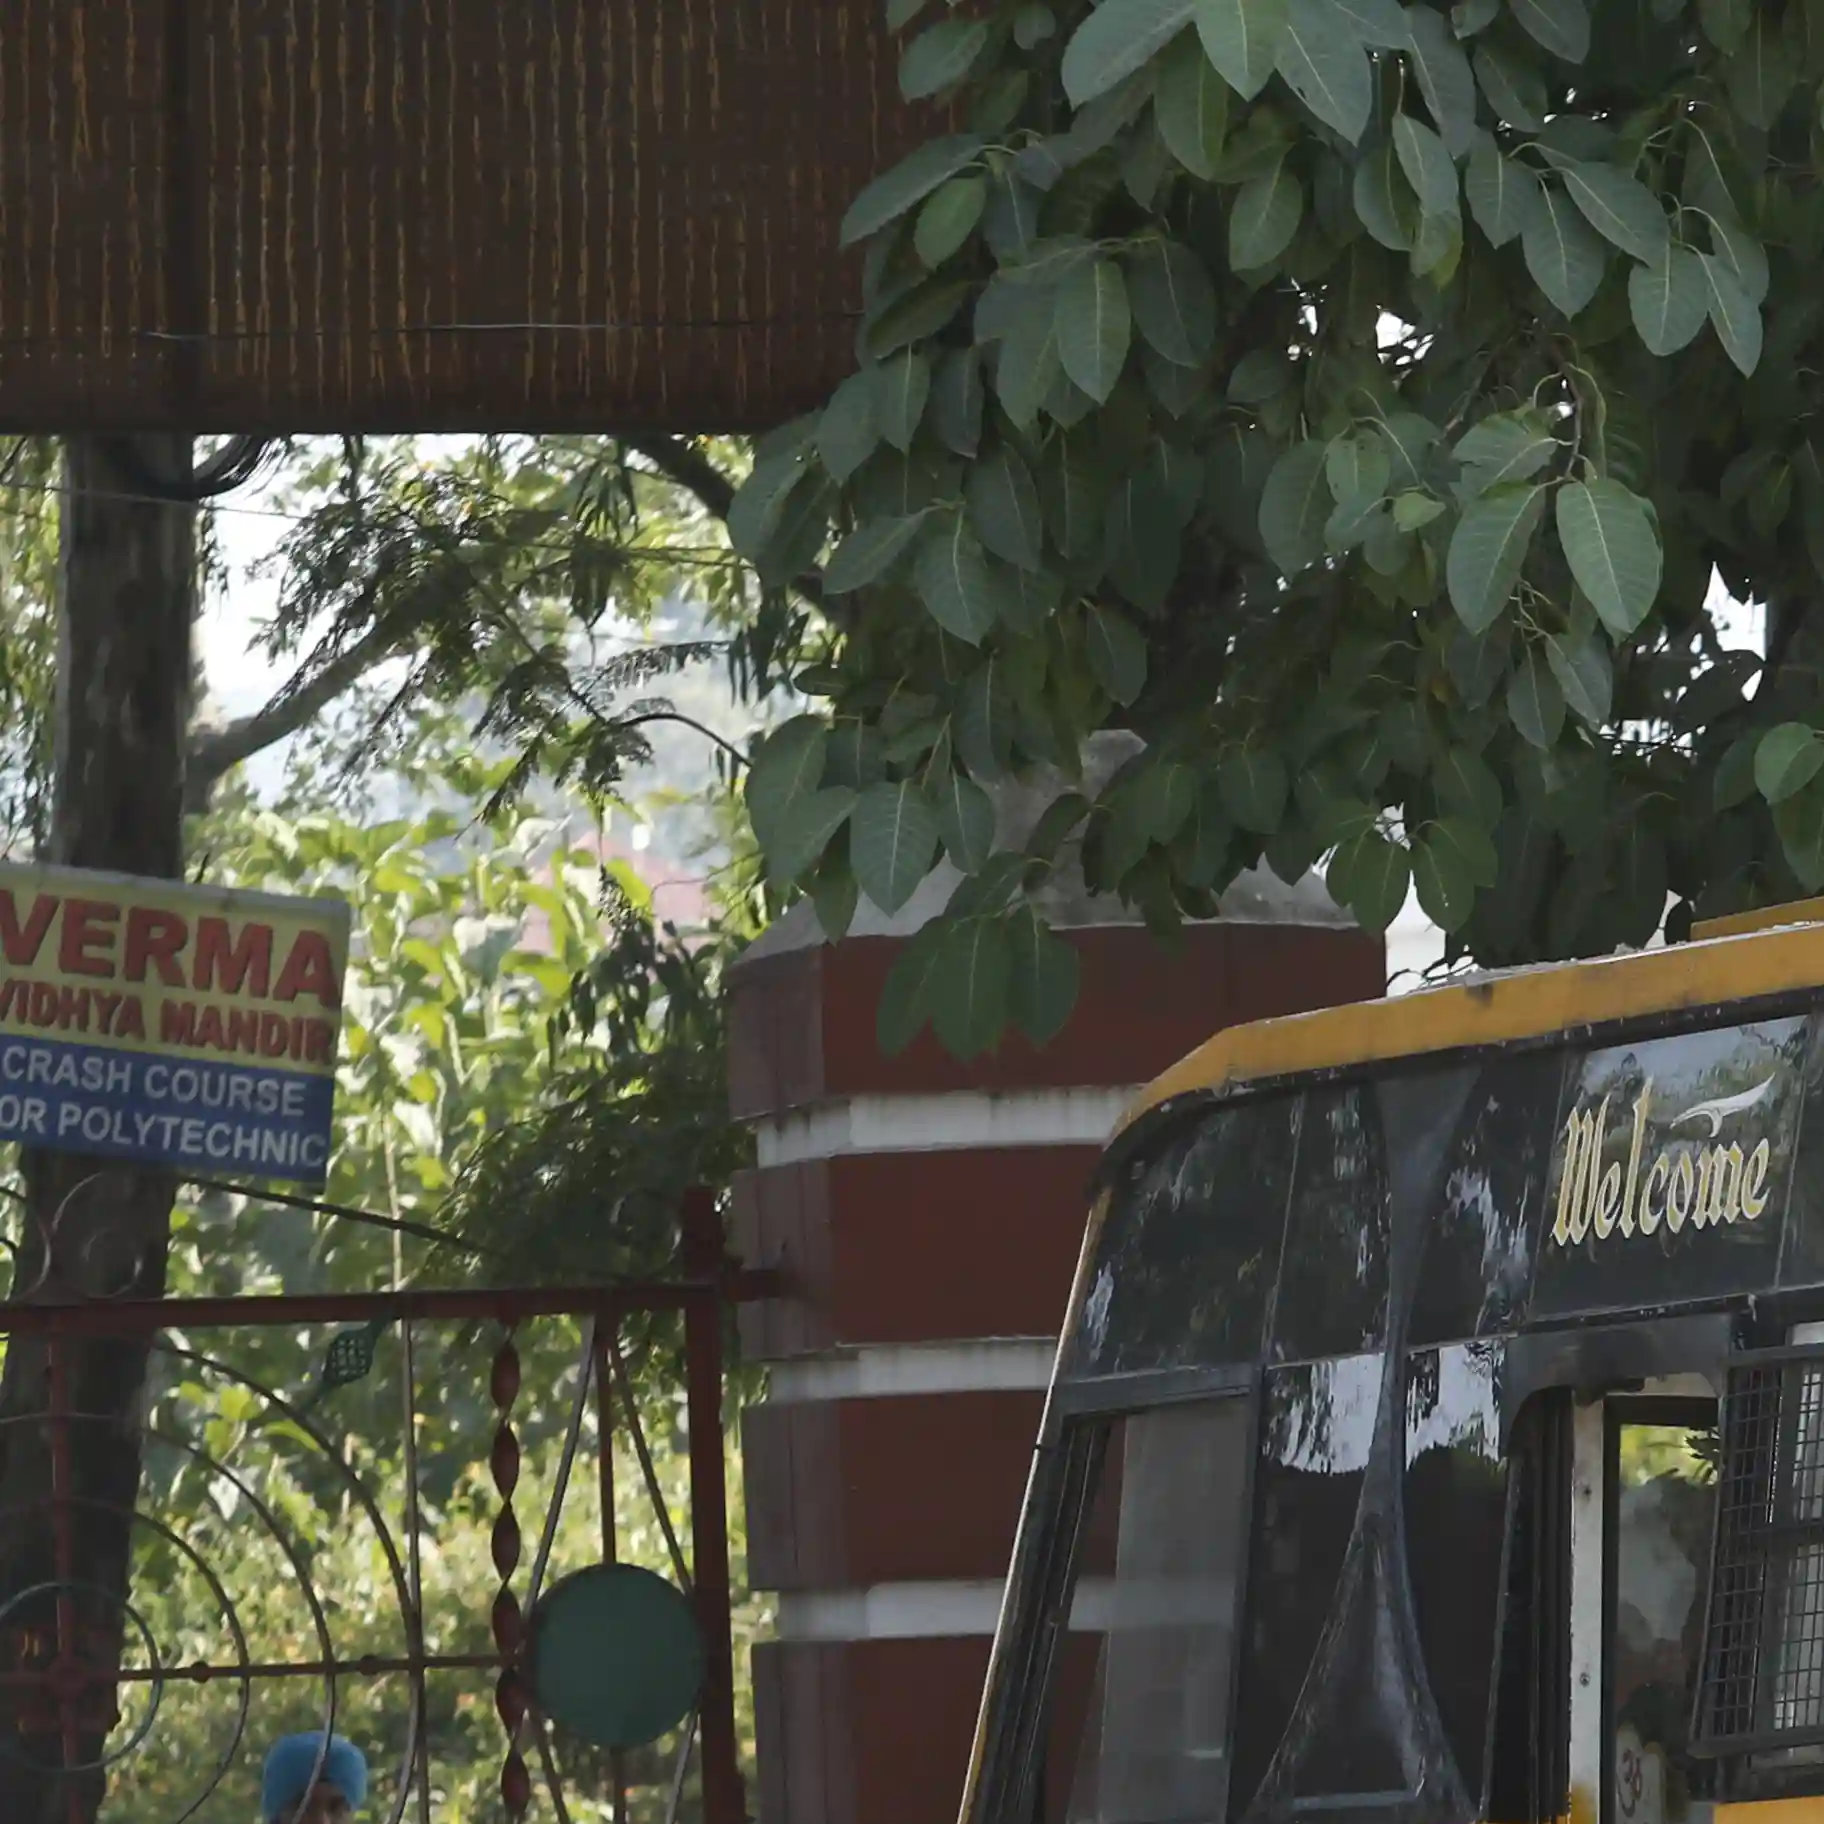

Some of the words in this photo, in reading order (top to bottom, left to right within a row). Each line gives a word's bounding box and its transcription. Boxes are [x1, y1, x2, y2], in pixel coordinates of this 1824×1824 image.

[0, 888, 338, 1012] VERMA
[159, 998, 334, 1066] MANDIR
[2, 1045, 132, 1094] CRASH
[144, 1066, 306, 1117] COURSE
[57, 1101, 327, 1167] POLYTECHNIC
[1550, 1075, 1771, 1246] Welcome
